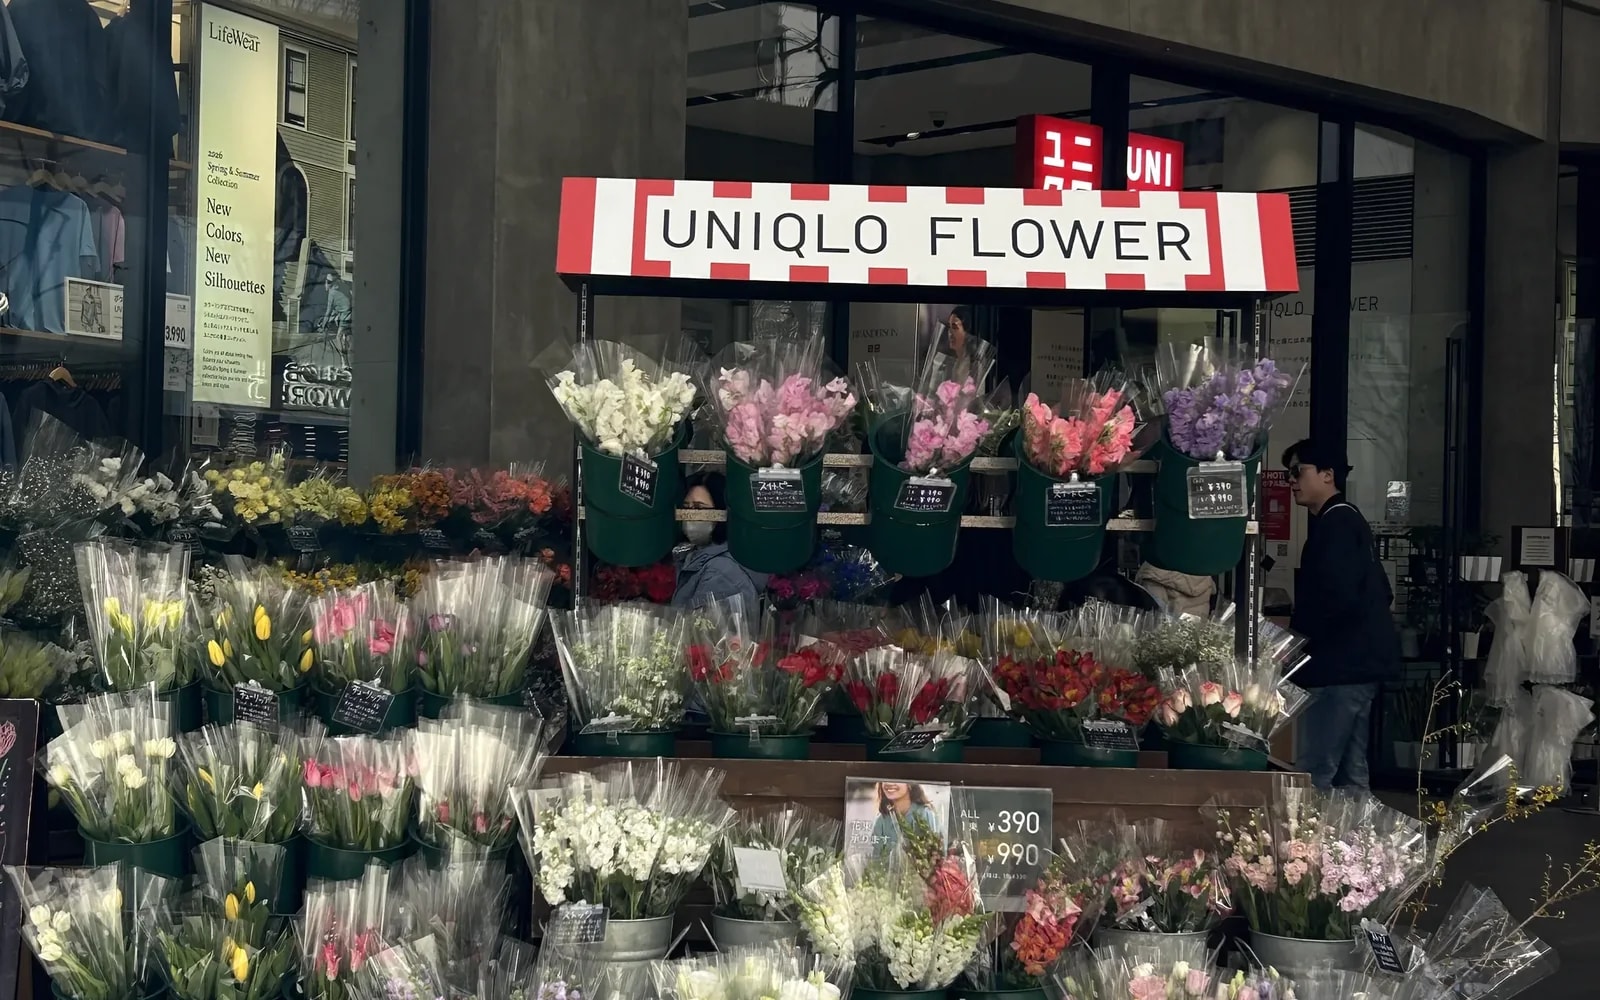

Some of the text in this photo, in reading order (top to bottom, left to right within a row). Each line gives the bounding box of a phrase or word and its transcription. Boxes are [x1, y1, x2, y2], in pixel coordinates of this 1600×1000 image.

[209, 22, 261, 53] LifeWear
[207, 150, 223, 160] 2026
[1126, 146, 1172, 187] UNI
[207, 162, 261, 181] Spring & Summer
[207, 174, 238, 189] Collection
[206, 197, 232, 217] New
[206, 222, 245, 246] Colors,
[662, 208, 1193, 262] UNIQLO FLOWER
[205, 246, 231, 265] New
[204, 271, 266, 295] Silhouettes
[960, 809, 980, 819] ALL
[988, 810, 1040, 835] ¥390
[987, 842, 1039, 867] ¥990
